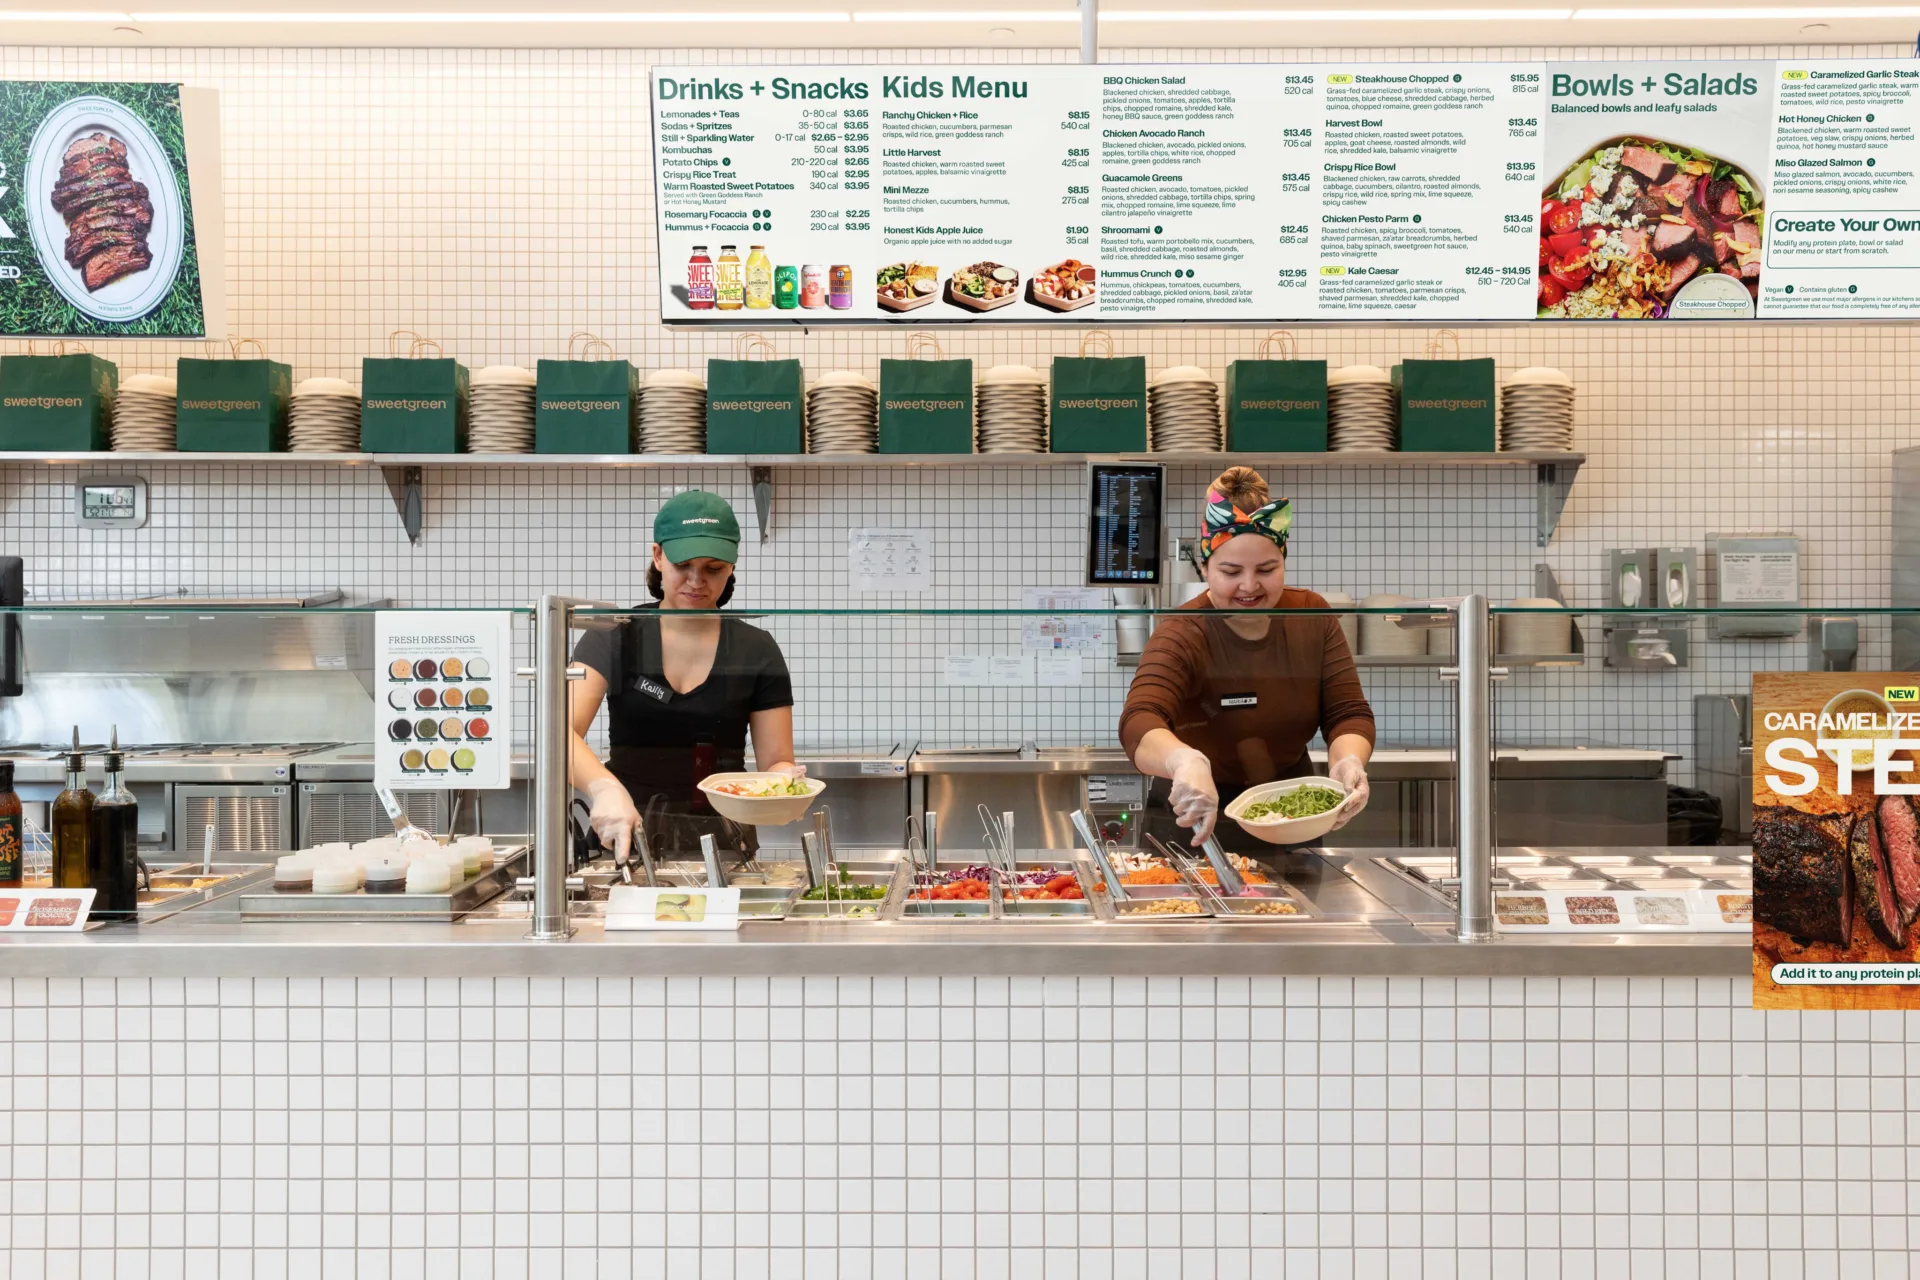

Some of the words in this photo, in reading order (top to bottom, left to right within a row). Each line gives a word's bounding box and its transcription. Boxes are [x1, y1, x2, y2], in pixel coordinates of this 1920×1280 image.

[1332, 75, 1349, 83] NEW
[1355, 75, 1408, 83] Steakhouse
[1408, 74, 1449, 84] Chopped
[1510, 74, 1540, 82] $15.95
[1810, 70, 1865, 79] Caramelized
[1866, 70, 1892, 78] Garlic
[1894, 70, 1920, 78] Steak
[1104, 76, 1124, 84] BBQ
[1124, 76, 1160, 84] Chicken
[1161, 76, 1186, 84] Salad
[1285, 76, 1314, 84] $13.45
[1552, 74, 1634, 96] Bowls
[1640, 76, 1657, 92] +
[1664, 72, 1758, 96] Salads
[659, 78, 744, 100] Drinks
[750, 80, 765, 96] +
[772, 77, 869, 100] Snacks
[883, 76, 944, 98] Kids
[952, 76, 1028, 98] Menu
[1551, 104, 1600, 113] Balanced
[1601, 104, 1632, 112] bowls
[1633, 103, 1654, 112] and
[1654, 102, 1682, 114] leafy
[1684, 102, 1718, 112] salads
[660, 110, 711, 118] Lemonades
[718, 110, 740, 118] Teas
[802, 109, 825, 118] 0-80
[826, 110, 838, 118] cal
[844, 109, 869, 118] $3.65
[882, 110, 915, 121] Ranchy
[916, 110, 951, 120] Chicken
[960, 110, 978, 120] Rice
[1068, 111, 1090, 120] $8.15
[1326, 120, 1360, 128] Harvest
[1362, 118, 1382, 127] Bowl
[1508, 118, 1538, 126] $13.45
[1778, 115, 1794, 123] Hot
[1796, 115, 1824, 124] Honey
[1826, 114, 1862, 122] Chicken
[696, 122, 732, 132] Spritzes
[844, 121, 869, 130] $3.65
[811, 134, 836, 142] $2.65
[844, 132, 870, 142] $2.95
[1102, 130, 1138, 138] Chicken
[1138, 130, 1176, 138] Avocado
[1178, 129, 1205, 137] Ranch
[1284, 128, 1312, 137] $13.45
[662, 134, 678, 142] Still
[686, 134, 728, 144] Sparkling
[728, 134, 754, 142] Water
[662, 146, 712, 154] Kombuchas
[844, 145, 870, 154] $3.95
[882, 148, 906, 156] Little
[908, 148, 941, 156] Harvest
[1068, 148, 1090, 156] $8.15
[693, 158, 718, 168] Chips
[844, 158, 870, 166] $2.65
[1506, 162, 1536, 170] $13.95
[1775, 159, 1796, 167] Miso
[1798, 158, 1828, 167] Glazed
[1829, 158, 1862, 166] Salmon
[1324, 163, 1353, 172] Crispy
[1354, 163, 1374, 171] Rice
[1374, 163, 1396, 171] Bowl
[663, 170, 692, 180] Crispy
[692, 170, 712, 178] Rice
[712, 170, 736, 178] Treat
[844, 170, 870, 178] $2.95
[1102, 174, 1150, 182] Guacamole
[1152, 174, 1183, 182] Greens
[1282, 173, 1310, 182] $13.45
[690, 182, 726, 190] Roasted
[726, 182, 754, 190] Sweet
[755, 182, 794, 190] Potatoes
[844, 182, 870, 190] $3.95
[902, 186, 929, 194] Mezze
[1068, 186, 1090, 194] $8.15
[664, 210, 708, 220] Rosemary
[709, 210, 748, 218] Focaccia
[846, 210, 870, 218] $2.25
[1322, 214, 1357, 223] Chicken
[1358, 214, 1384, 223] Pesto
[1386, 214, 1408, 222] Parm
[1504, 214, 1534, 222] $13.45
[712, 223, 749, 231] Focaccia
[845, 222, 870, 230] $3.95
[1280, 225, 1308, 234] $12.45
[1775, 218, 1836, 232] Create
[1840, 218, 1880, 232] Your
[1883, 218, 1920, 232] Own
[916, 226, 934, 234] Kids
[936, 226, 961, 236] Apple
[962, 226, 984, 234] Juice
[1066, 226, 1089, 234] $1.90
[1101, 226, 1150, 234] Shroomami
[1774, 240, 1798, 248] Modify
[1838, 240, 1858, 248] plate,
[1140, 270, 1172, 278] Crunch
[1279, 268, 1307, 277] $12.95
[1325, 267, 1341, 275] NEW
[1348, 266, 1367, 274] Kale
[1368, 266, 1400, 274] Caesar
[1466, 266, 1494, 275] $12.45
[1502, 266, 1531, 275] $14.95
[1764, 286, 1784, 294] Vegan
[1717, 300, 1748, 308] Chopped
[4, 396, 82, 409] sweetgreen
[182, 400, 260, 412] sweetgreen
[366, 399, 446, 412] sweetgreen
[541, 400, 620, 412] sweetgreen
[712, 400, 792, 412] sweetgreen
[885, 400, 964, 412] sweetgreen
[1059, 398, 1138, 410] sweetgreen
[1240, 400, 1320, 412] sweetgreen
[1408, 399, 1487, 411] sweetgreen
[388, 636, 420, 644] FRESH
[421, 636, 476, 644] DRESSINGS
[1888, 690, 1914, 698] NEW
[1764, 712, 1920, 730] CARAMELIZE
[1780, 968, 1805, 978] Add
[1808, 968, 1817, 978] it
[1818, 969, 1832, 978] to
[1834, 970, 1858, 981] any
[1860, 968, 1904, 980] protein
